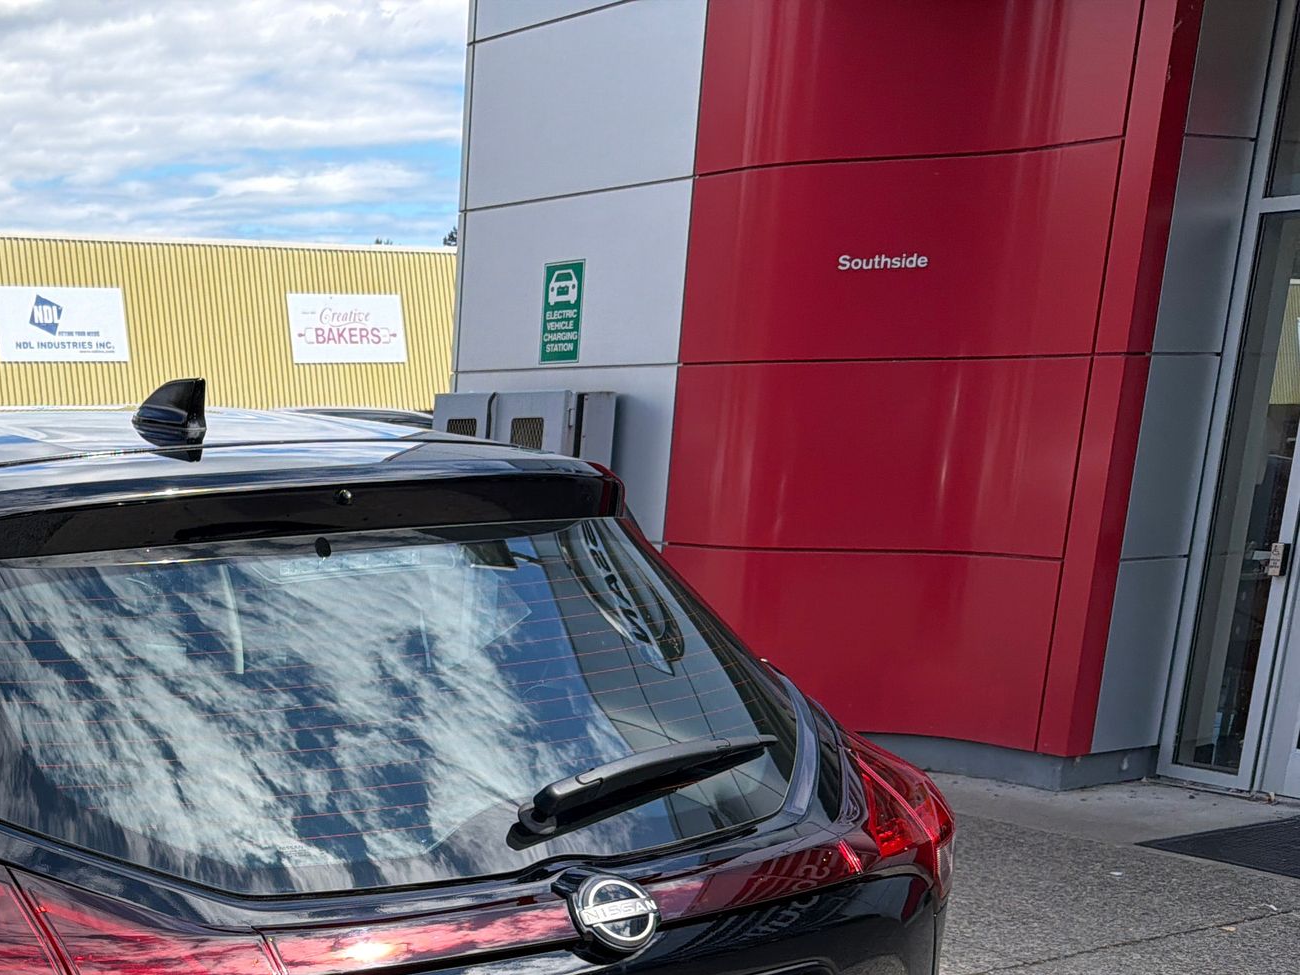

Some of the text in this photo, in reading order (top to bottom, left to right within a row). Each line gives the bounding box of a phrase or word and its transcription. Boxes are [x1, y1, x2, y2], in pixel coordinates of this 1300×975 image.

[837, 253, 929, 271] Southside
[33, 305, 60, 324] NDL
[319, 306, 371, 327] Creative
[545, 309, 578, 321] ELECTRIC
[546, 320, 574, 331] VEHICLE
[314, 327, 382, 345] BAKERS
[543, 331, 578, 342] CHARGING
[15, 341, 115, 350] NDL INDUSTRIES INC.
[545, 342, 574, 353] STATION
[584, 899, 658, 922] NISSAN
